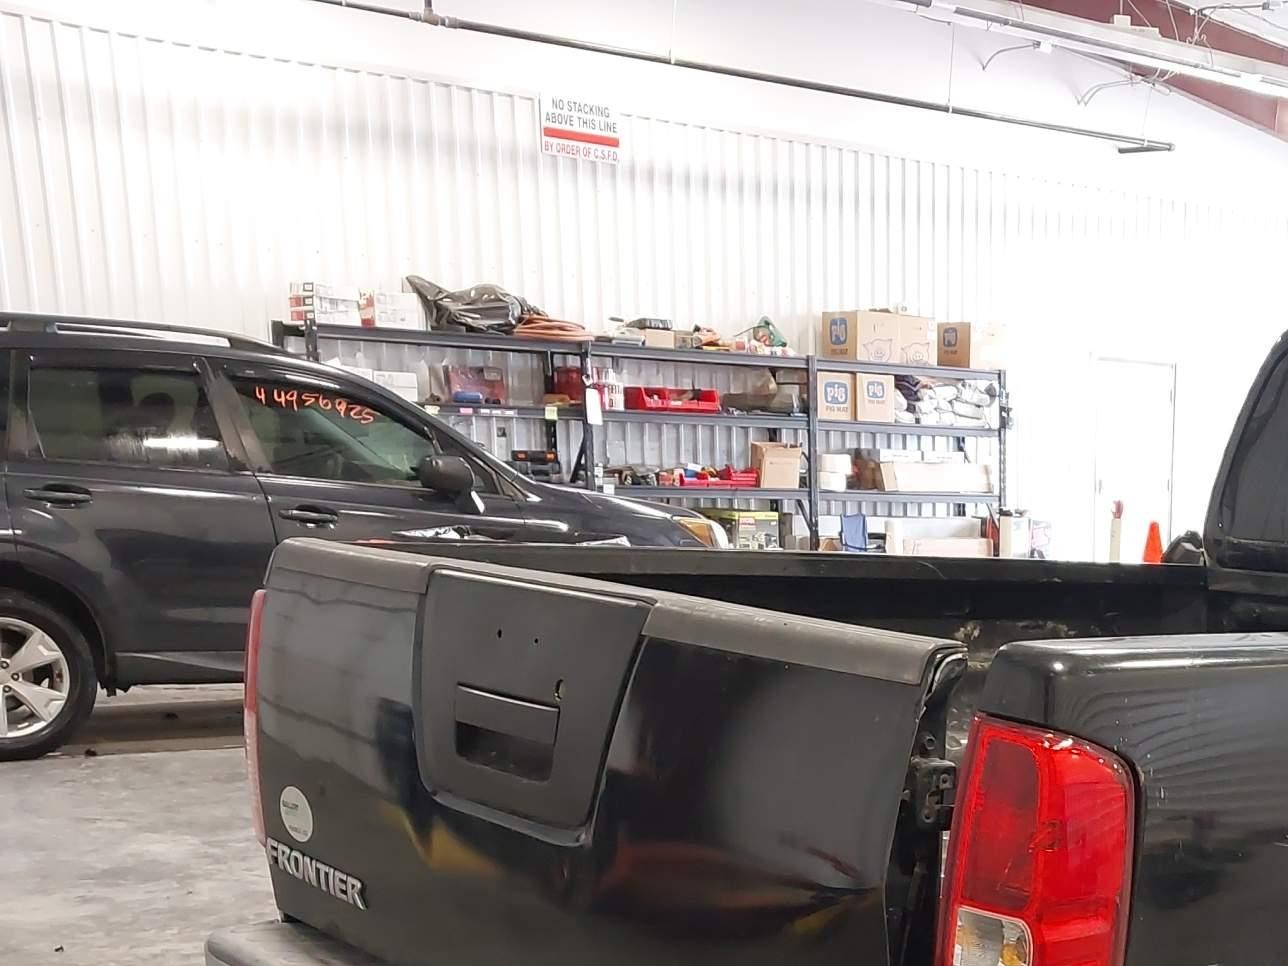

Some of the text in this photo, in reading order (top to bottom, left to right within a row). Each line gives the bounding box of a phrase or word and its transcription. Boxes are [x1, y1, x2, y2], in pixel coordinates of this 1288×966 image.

[552, 98, 610, 118] NO STACKING
[545, 112, 617, 133] ABOVE THIS LINE
[544, 141, 554, 152] BY
[556, 143, 580, 156] ORDER
[583, 146, 591, 158] OF
[827, 383, 846, 401] pig
[266, 837, 368, 911] FRONTIER
